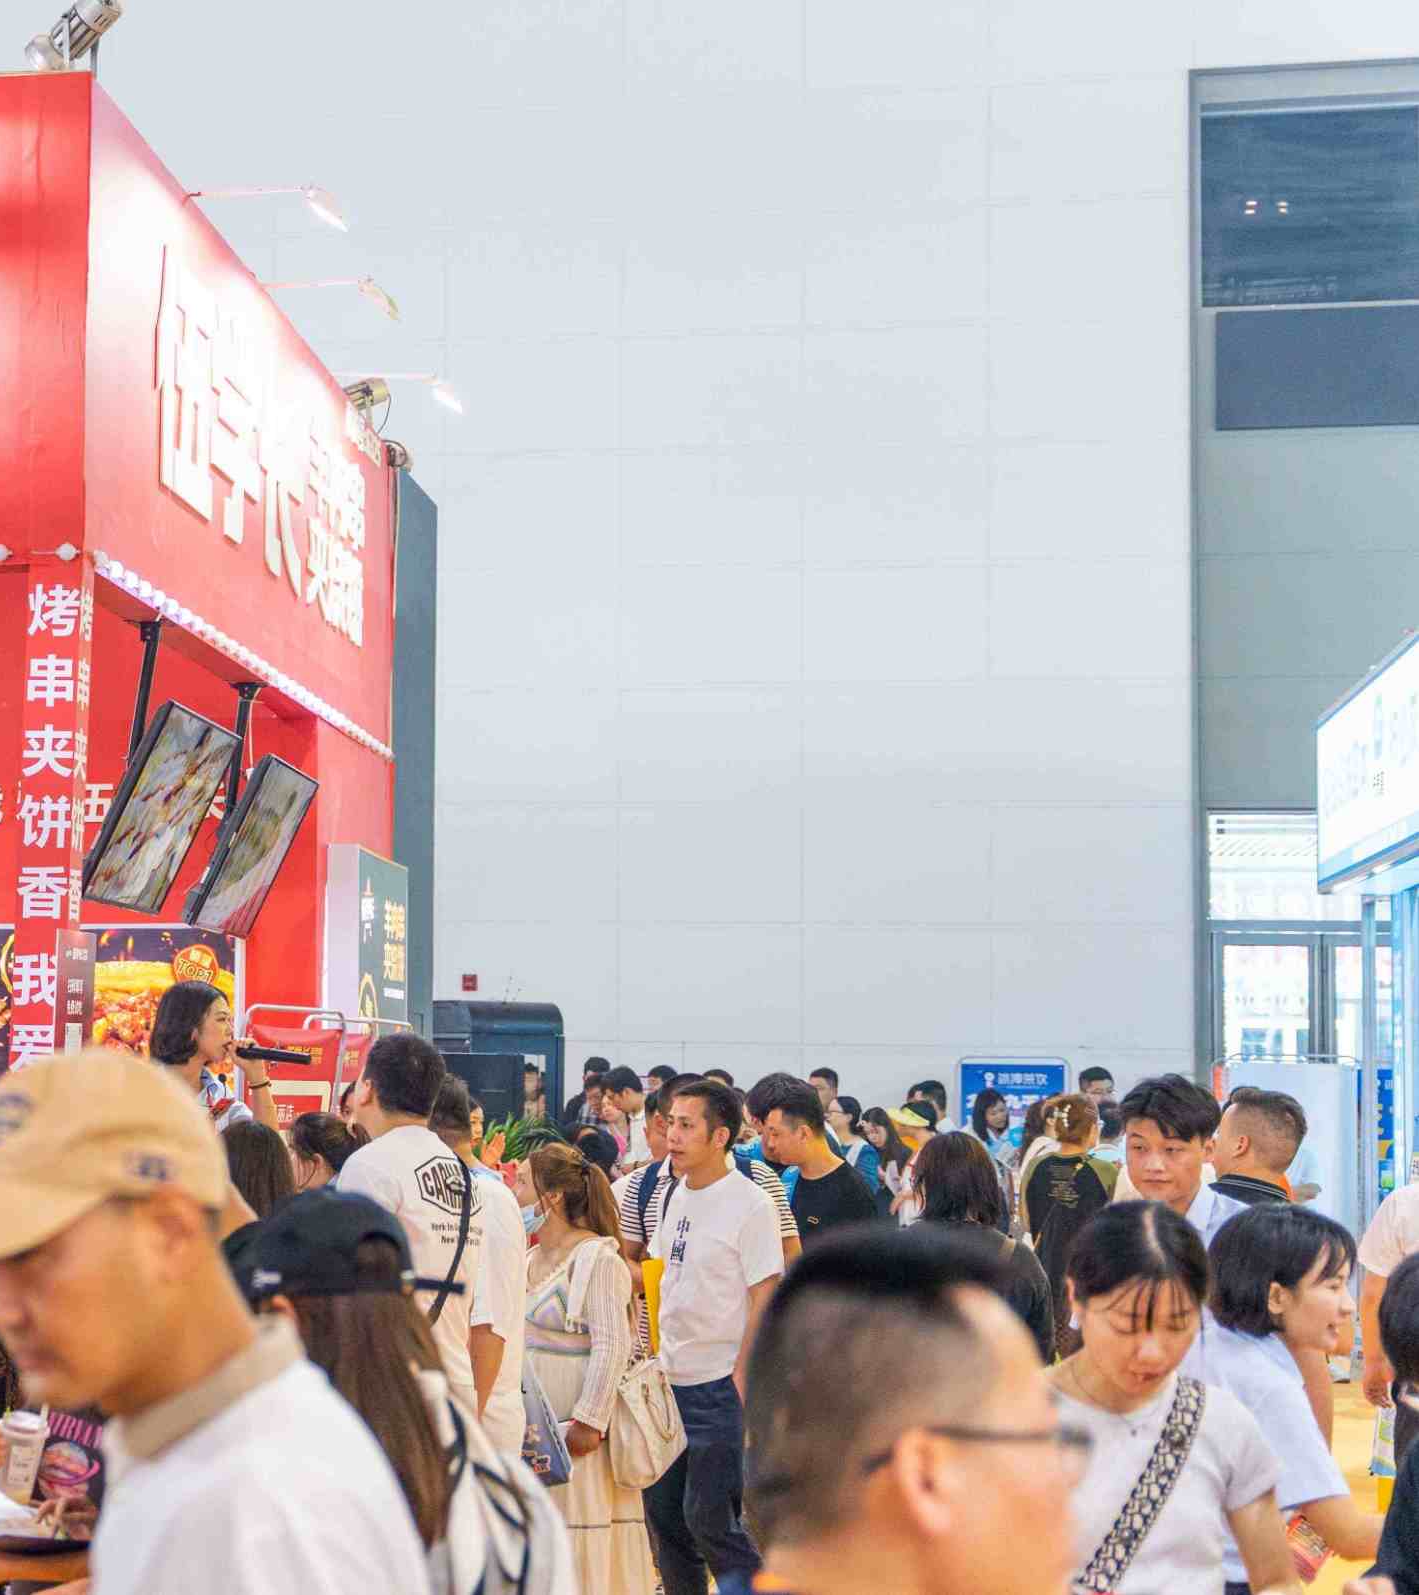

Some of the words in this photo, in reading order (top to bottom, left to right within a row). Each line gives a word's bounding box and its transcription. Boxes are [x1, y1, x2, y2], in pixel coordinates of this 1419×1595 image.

[17, 583, 81, 919] 烤串夹饼香
